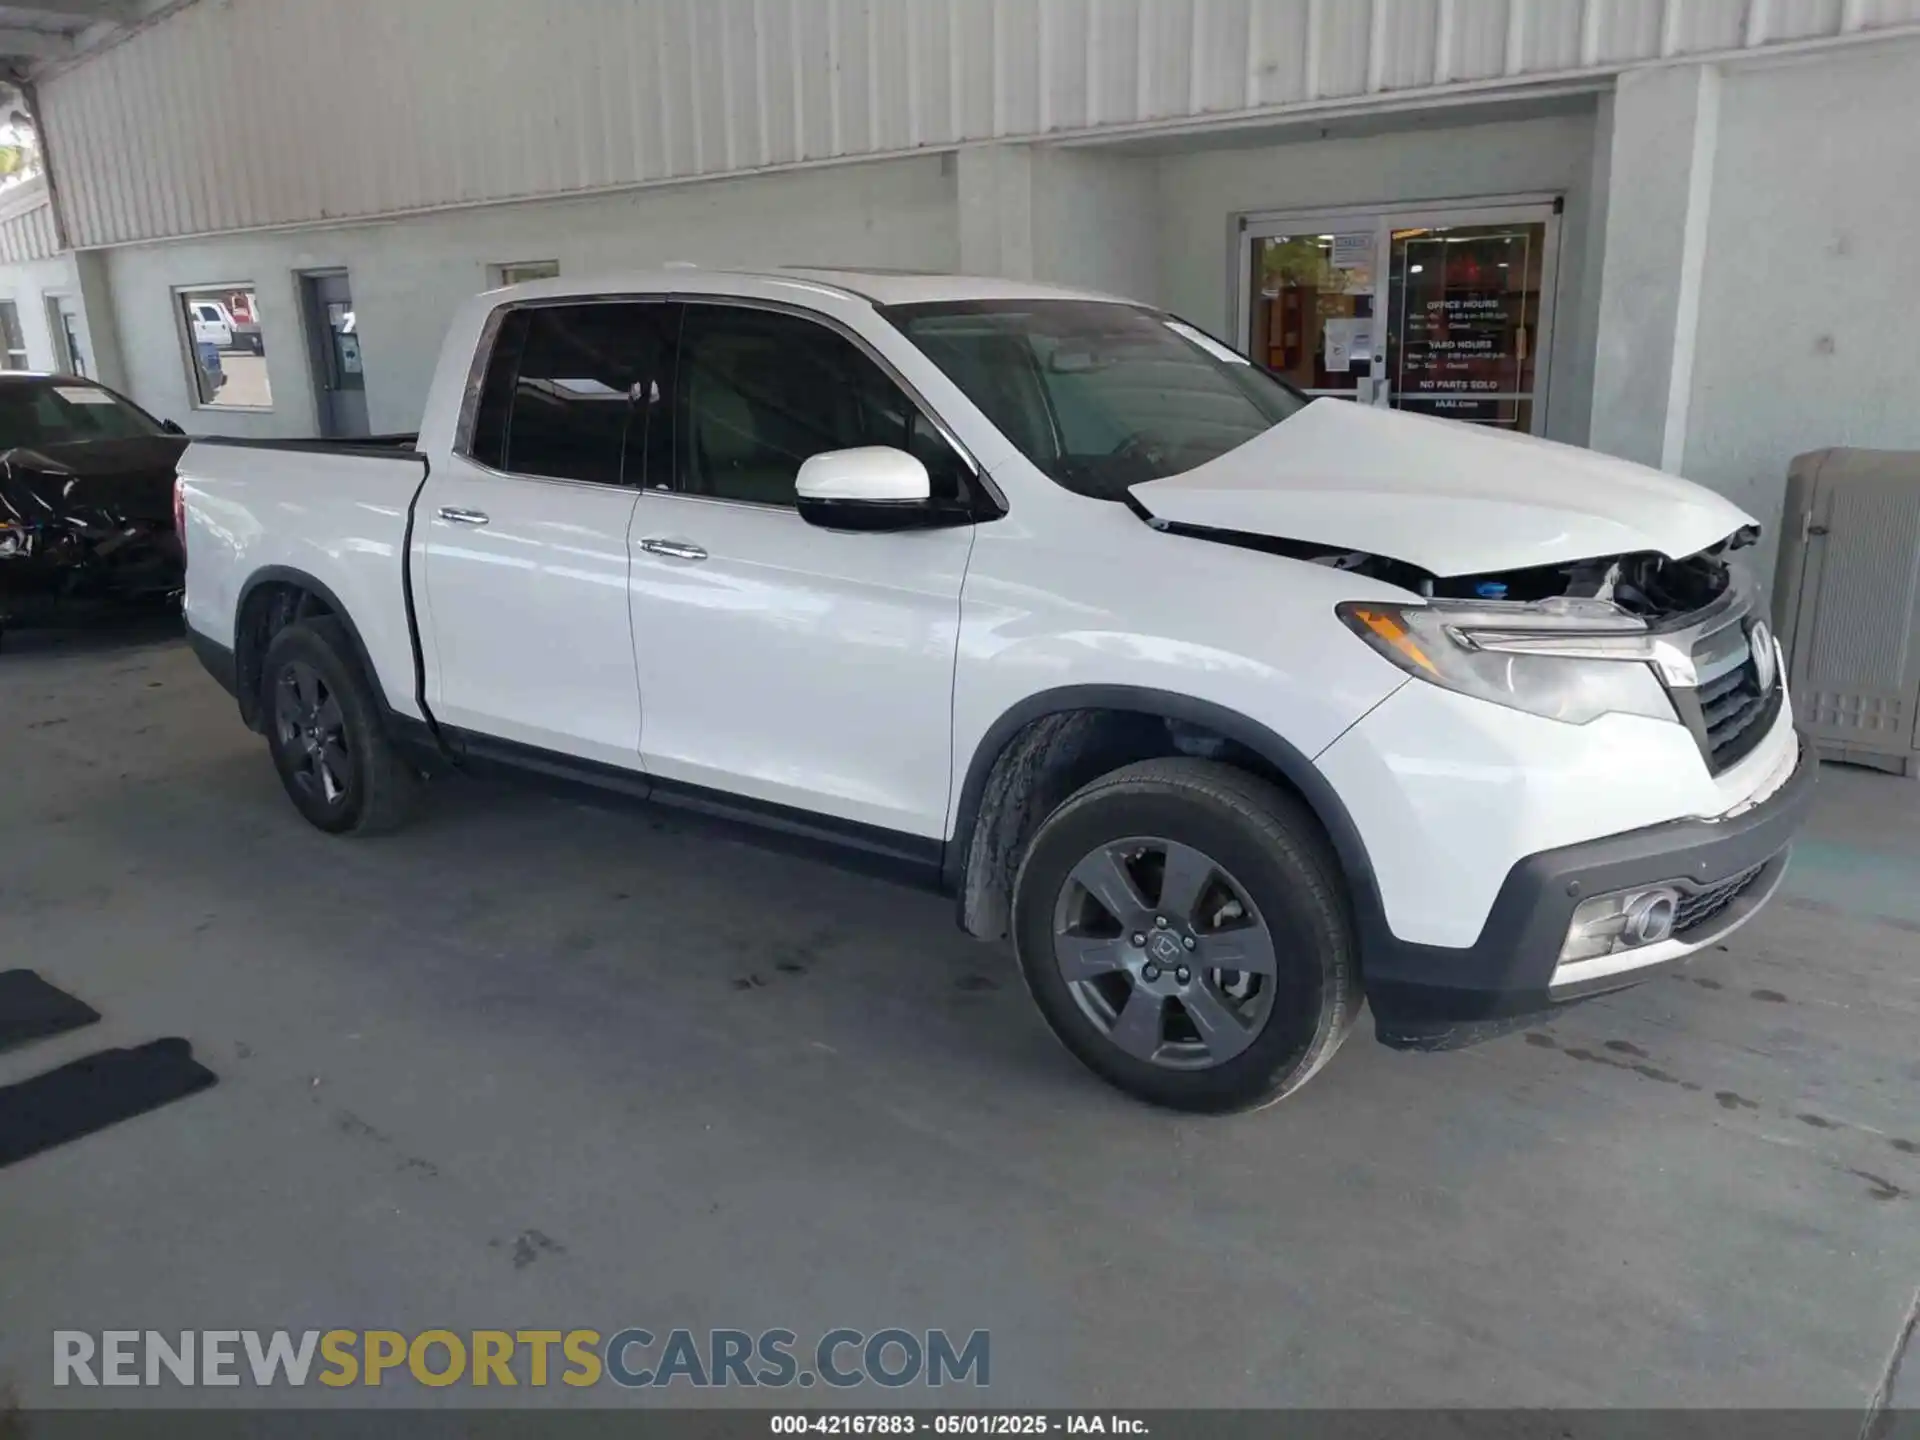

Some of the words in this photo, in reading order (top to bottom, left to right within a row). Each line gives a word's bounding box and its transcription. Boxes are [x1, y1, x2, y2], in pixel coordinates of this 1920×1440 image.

[1426, 301, 1460, 310] OFFICE
[1463, 300, 1499, 309] HOURS
[1428, 340, 1456, 349] YARD
[1457, 340, 1492, 349] HOURS
[1419, 380, 1434, 389] NO
[1436, 380, 1468, 389] PARTS
[1470, 380, 1498, 389] SOLD
